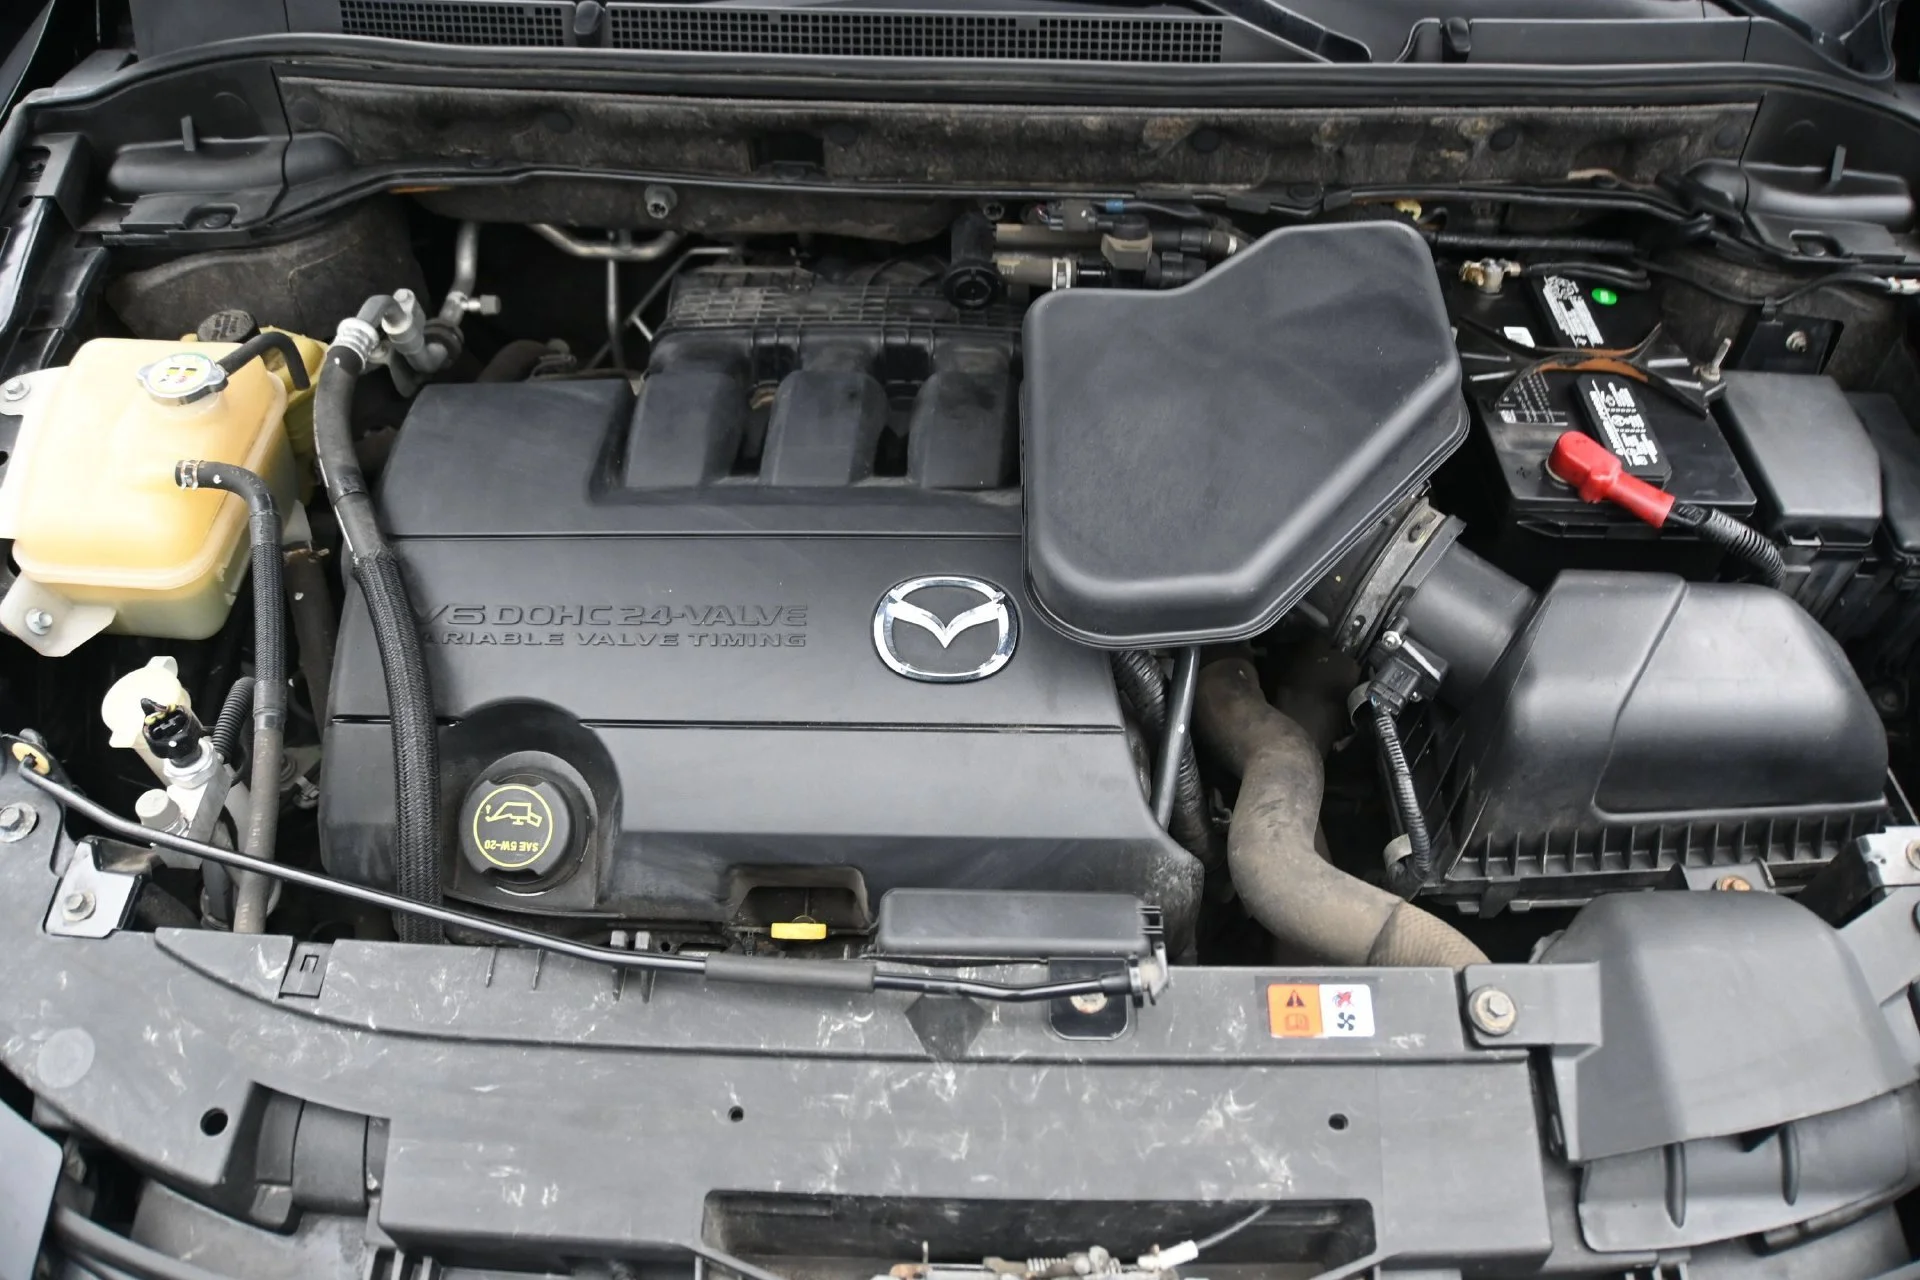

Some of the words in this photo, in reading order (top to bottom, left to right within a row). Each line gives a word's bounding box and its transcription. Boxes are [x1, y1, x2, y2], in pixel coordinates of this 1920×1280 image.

[492, 603, 613, 626] DOHC
[616, 604, 809, 627] 24-VALVE
[420, 631, 564, 646] ARIABLE
[577, 631, 680, 647] VALVE
[688, 632, 807, 648] TIMING
[484, 839, 517, 852] 5W-20
[518, 841, 539, 853] SAE
